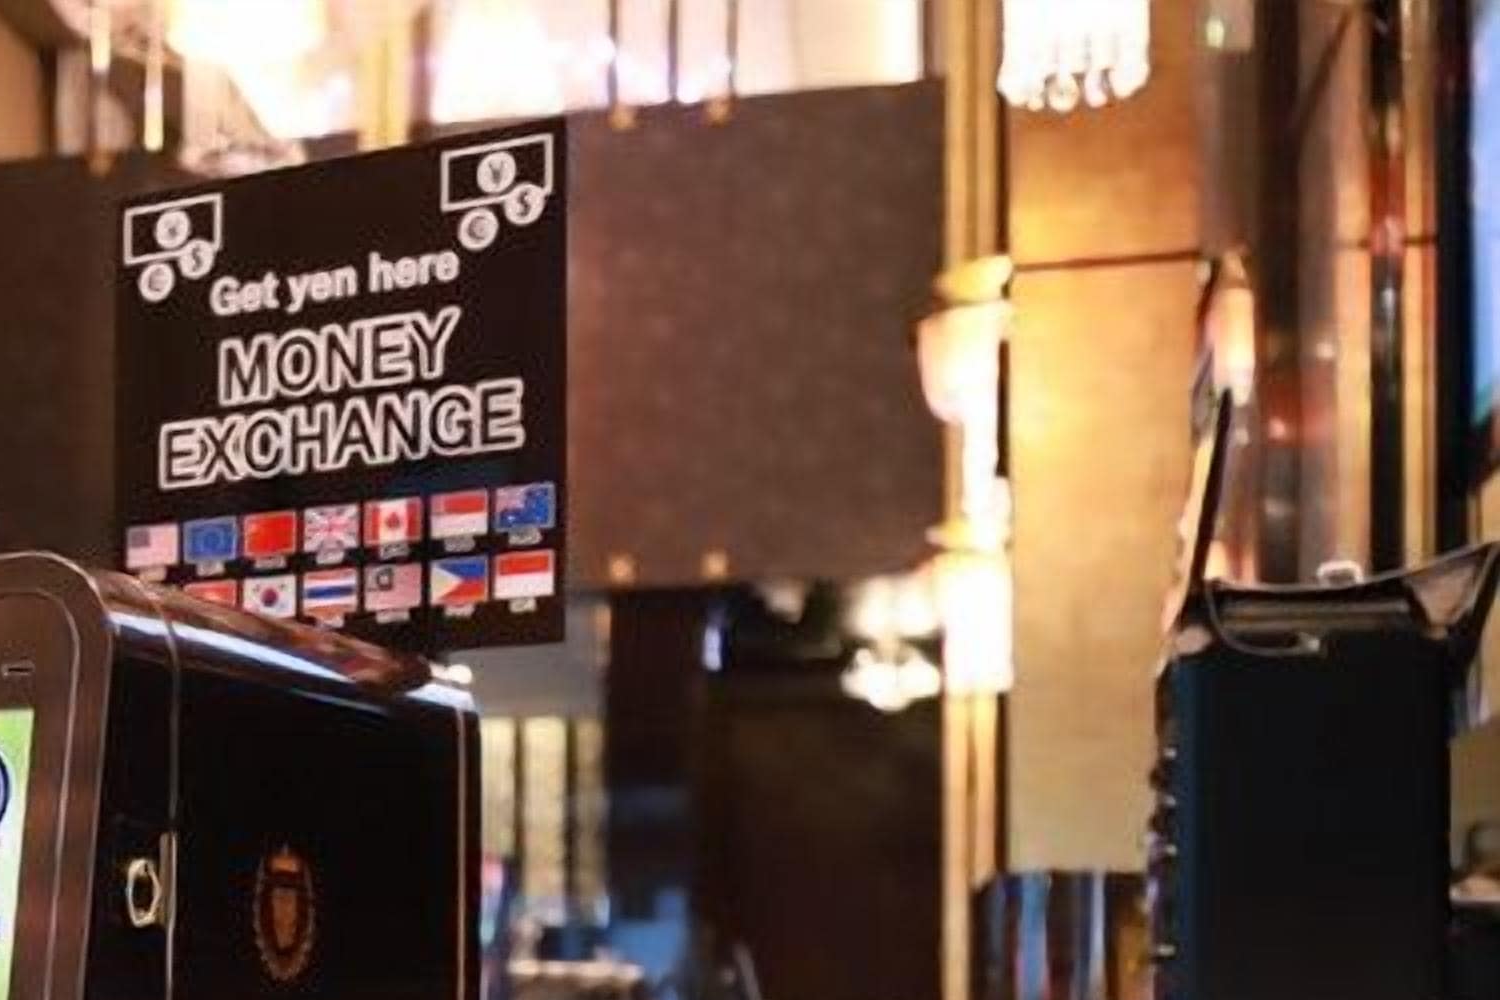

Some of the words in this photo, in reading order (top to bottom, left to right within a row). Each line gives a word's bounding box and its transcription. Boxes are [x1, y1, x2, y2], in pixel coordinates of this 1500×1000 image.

[209, 271, 280, 316] Get
[287, 263, 358, 314] yen
[367, 250, 461, 294] here
[217, 305, 461, 407] MONEY
[158, 376, 526, 489] EXCHANGE
